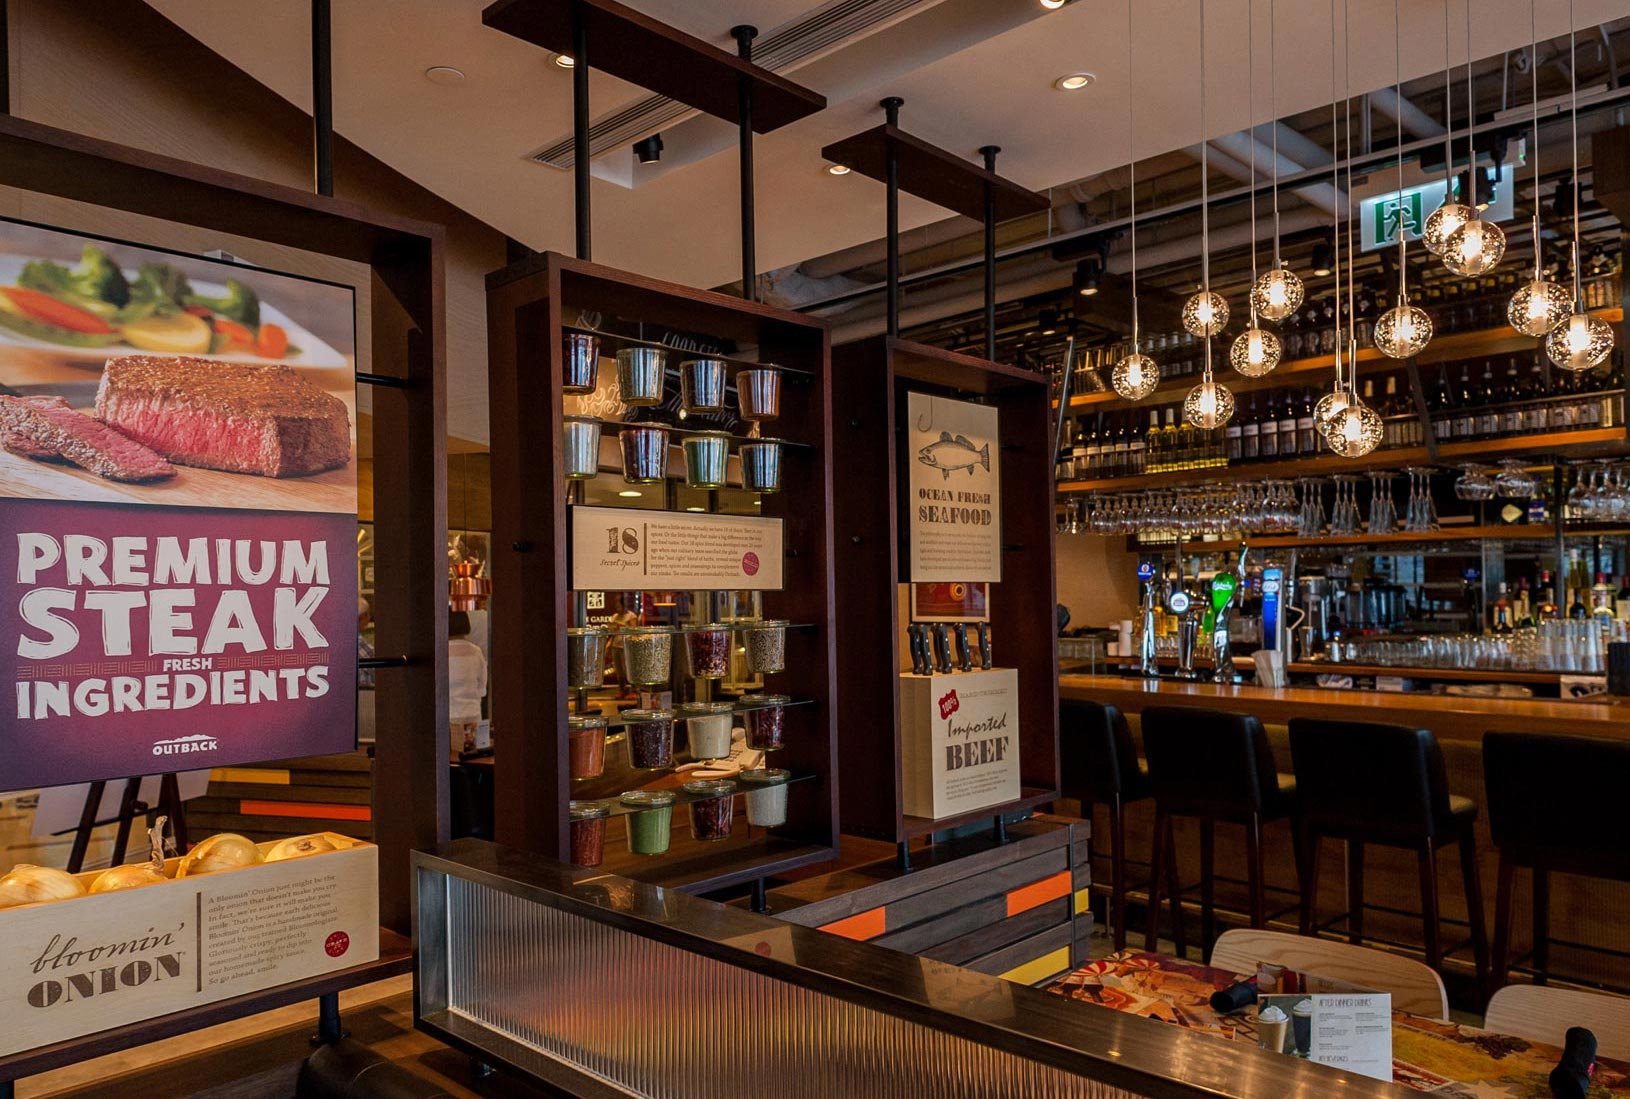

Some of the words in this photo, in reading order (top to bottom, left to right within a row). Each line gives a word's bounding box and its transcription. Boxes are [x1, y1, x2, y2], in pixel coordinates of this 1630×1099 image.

[919, 488, 953, 502] OCEAN
[958, 491, 991, 504] FRESH
[919, 505, 992, 526] SEAFOOD
[605, 527, 639, 554] 18
[17, 533, 330, 586] PREMIUM
[17, 587, 330, 660] STEAK
[163, 657, 213, 672] FRESH
[16, 666, 330, 720] INGREDIENTS
[948, 711, 1007, 741] Imported
[152, 740, 218, 756] OUTBACK
[945, 736, 1009, 771] BEEF
[30, 922, 185, 975] bloomin'
[27, 951, 184, 1008] ONION
